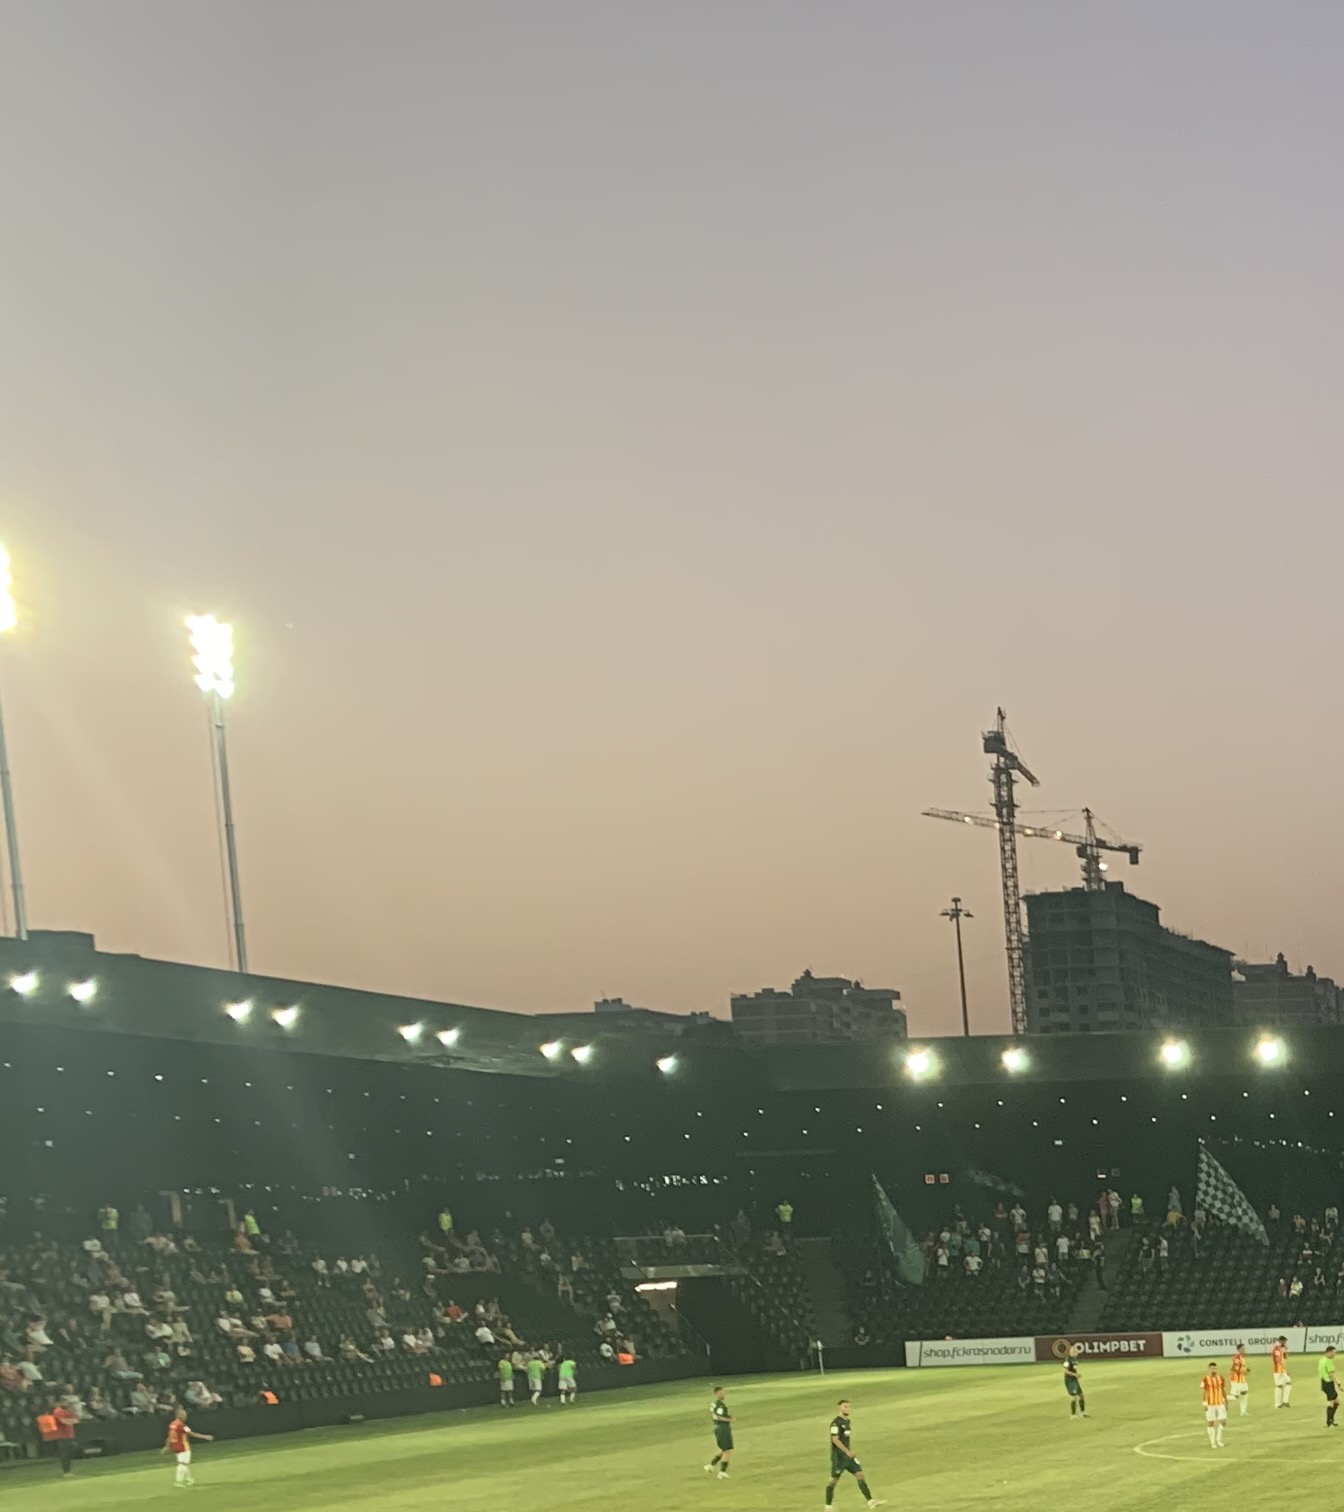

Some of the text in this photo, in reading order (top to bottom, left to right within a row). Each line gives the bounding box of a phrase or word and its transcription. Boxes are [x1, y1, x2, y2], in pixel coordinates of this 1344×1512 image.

[1074, 1340, 1146, 1354] OLIMPBET
[1199, 1338, 1244, 1347] CONSTELL
[923, 1345, 1032, 1359] shop.fckrasnodar.ru
